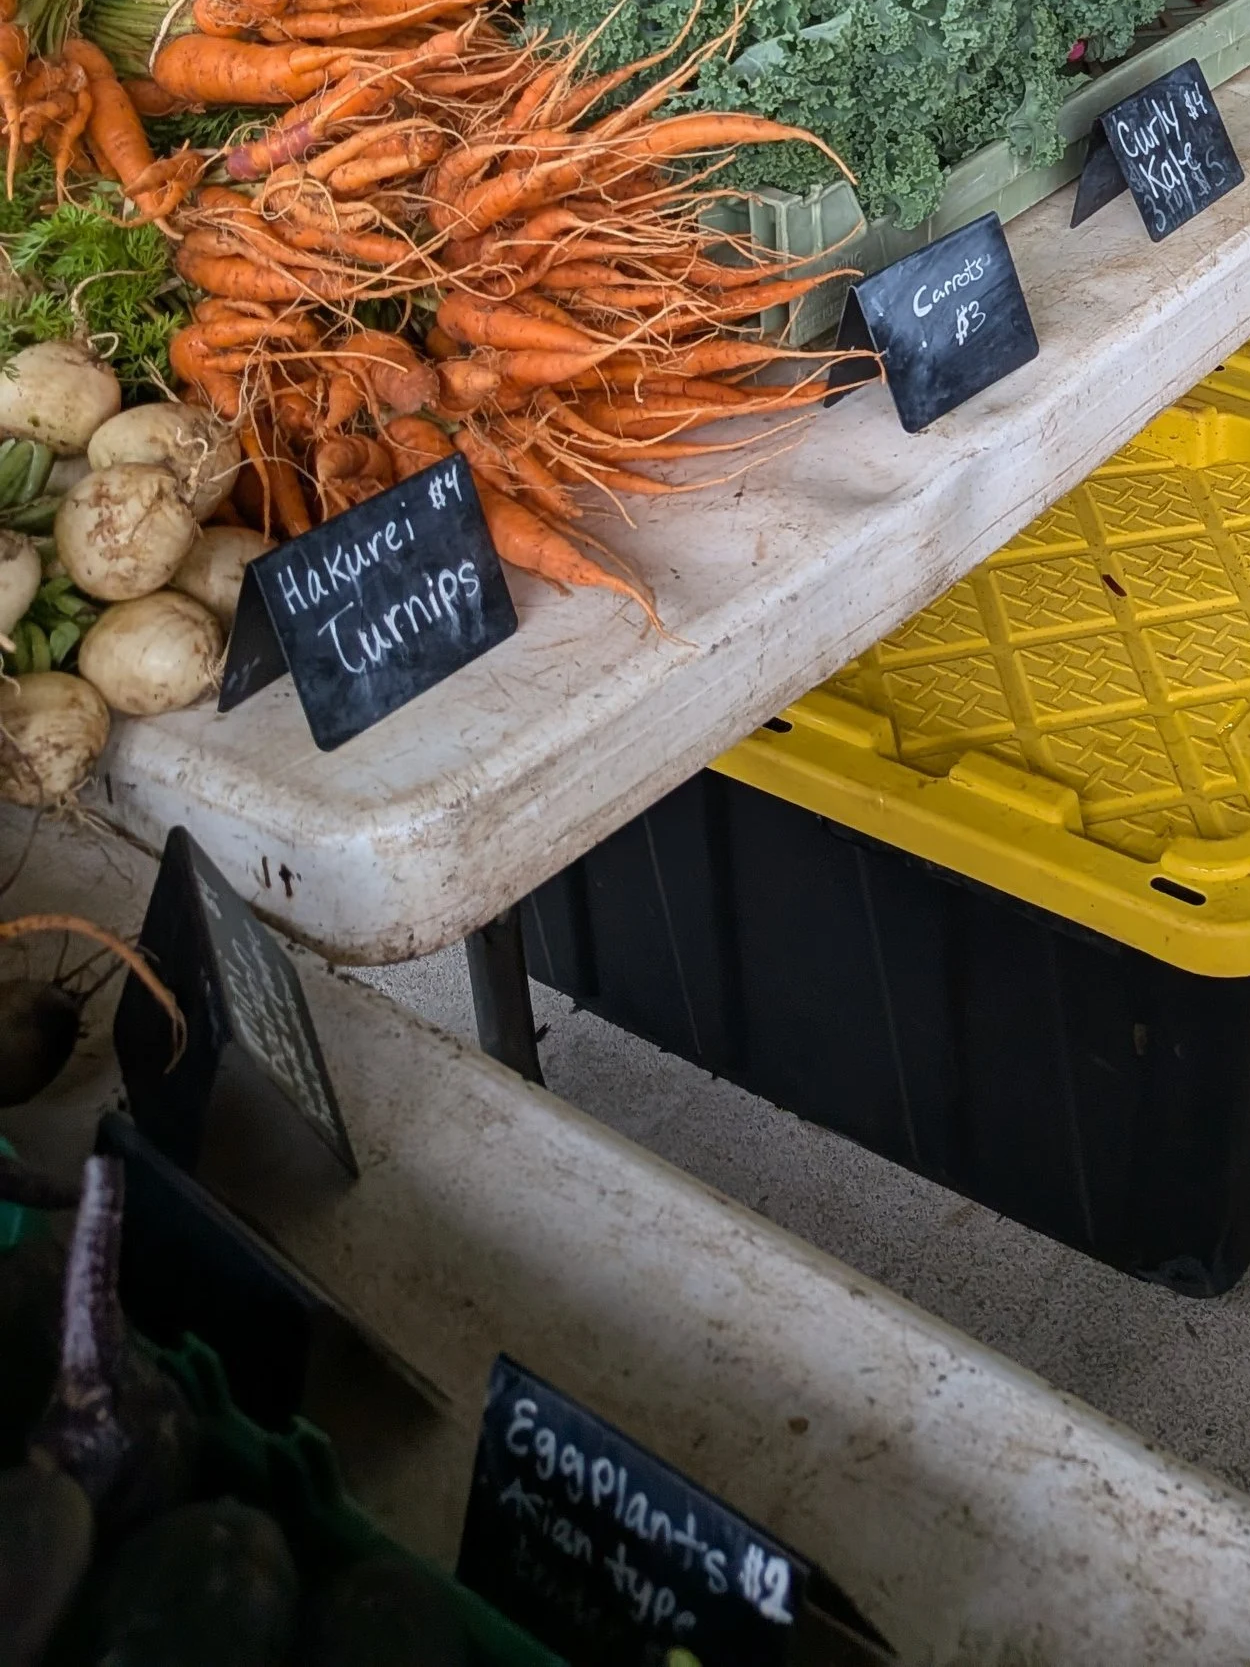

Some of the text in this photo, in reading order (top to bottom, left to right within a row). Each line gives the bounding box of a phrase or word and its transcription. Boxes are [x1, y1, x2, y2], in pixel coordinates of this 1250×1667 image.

[1117, 81, 1209, 158] Curly $4
[1139, 141, 1202, 199] Kale
[912, 257, 985, 319] Carrots
[955, 299, 987, 347] $3
[276, 464, 463, 616] Hakurei $4
[316, 560, 481, 675] Turnips
[505, 1397, 730, 1595] Eggplants
